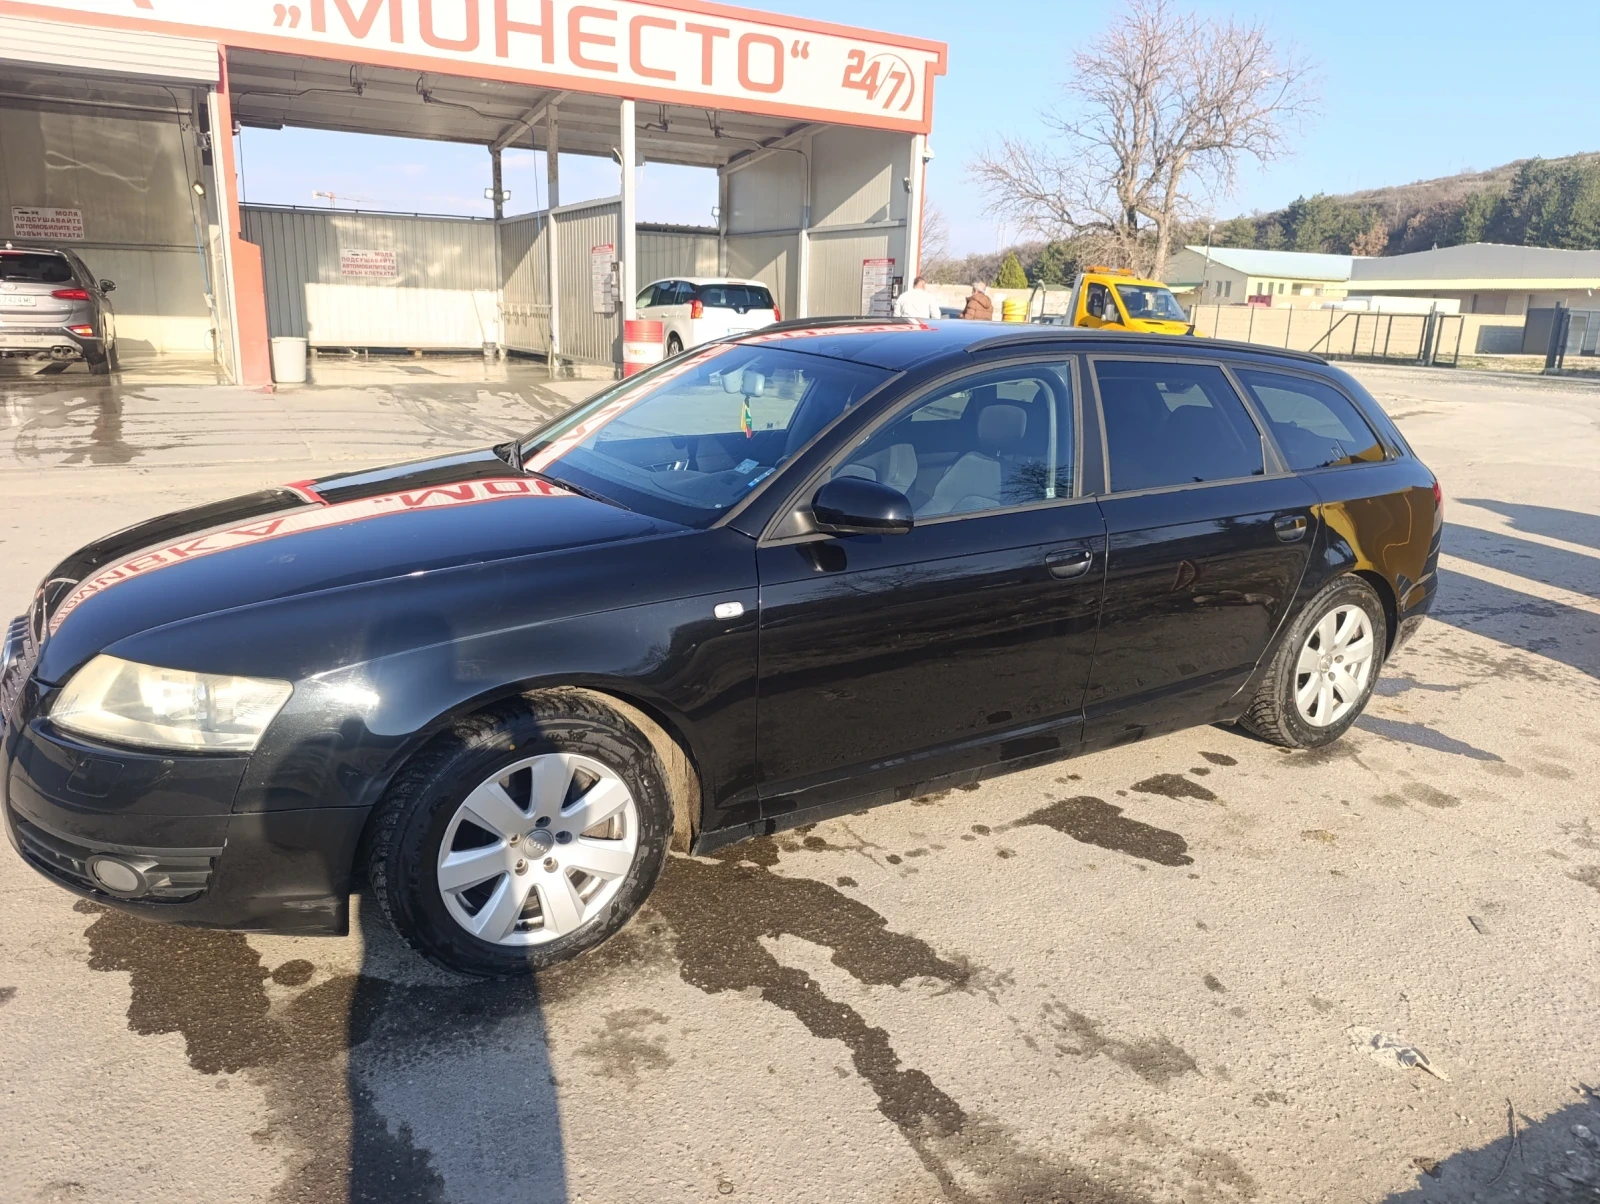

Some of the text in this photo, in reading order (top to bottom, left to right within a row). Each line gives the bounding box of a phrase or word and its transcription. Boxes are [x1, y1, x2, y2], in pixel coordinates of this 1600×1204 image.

[841, 49, 906, 110] 24/7
[14, 216, 82, 224] ПОДСУШАВАЙТЕ
[15, 223, 71, 231] АВТОМОБИЛИТЕ
